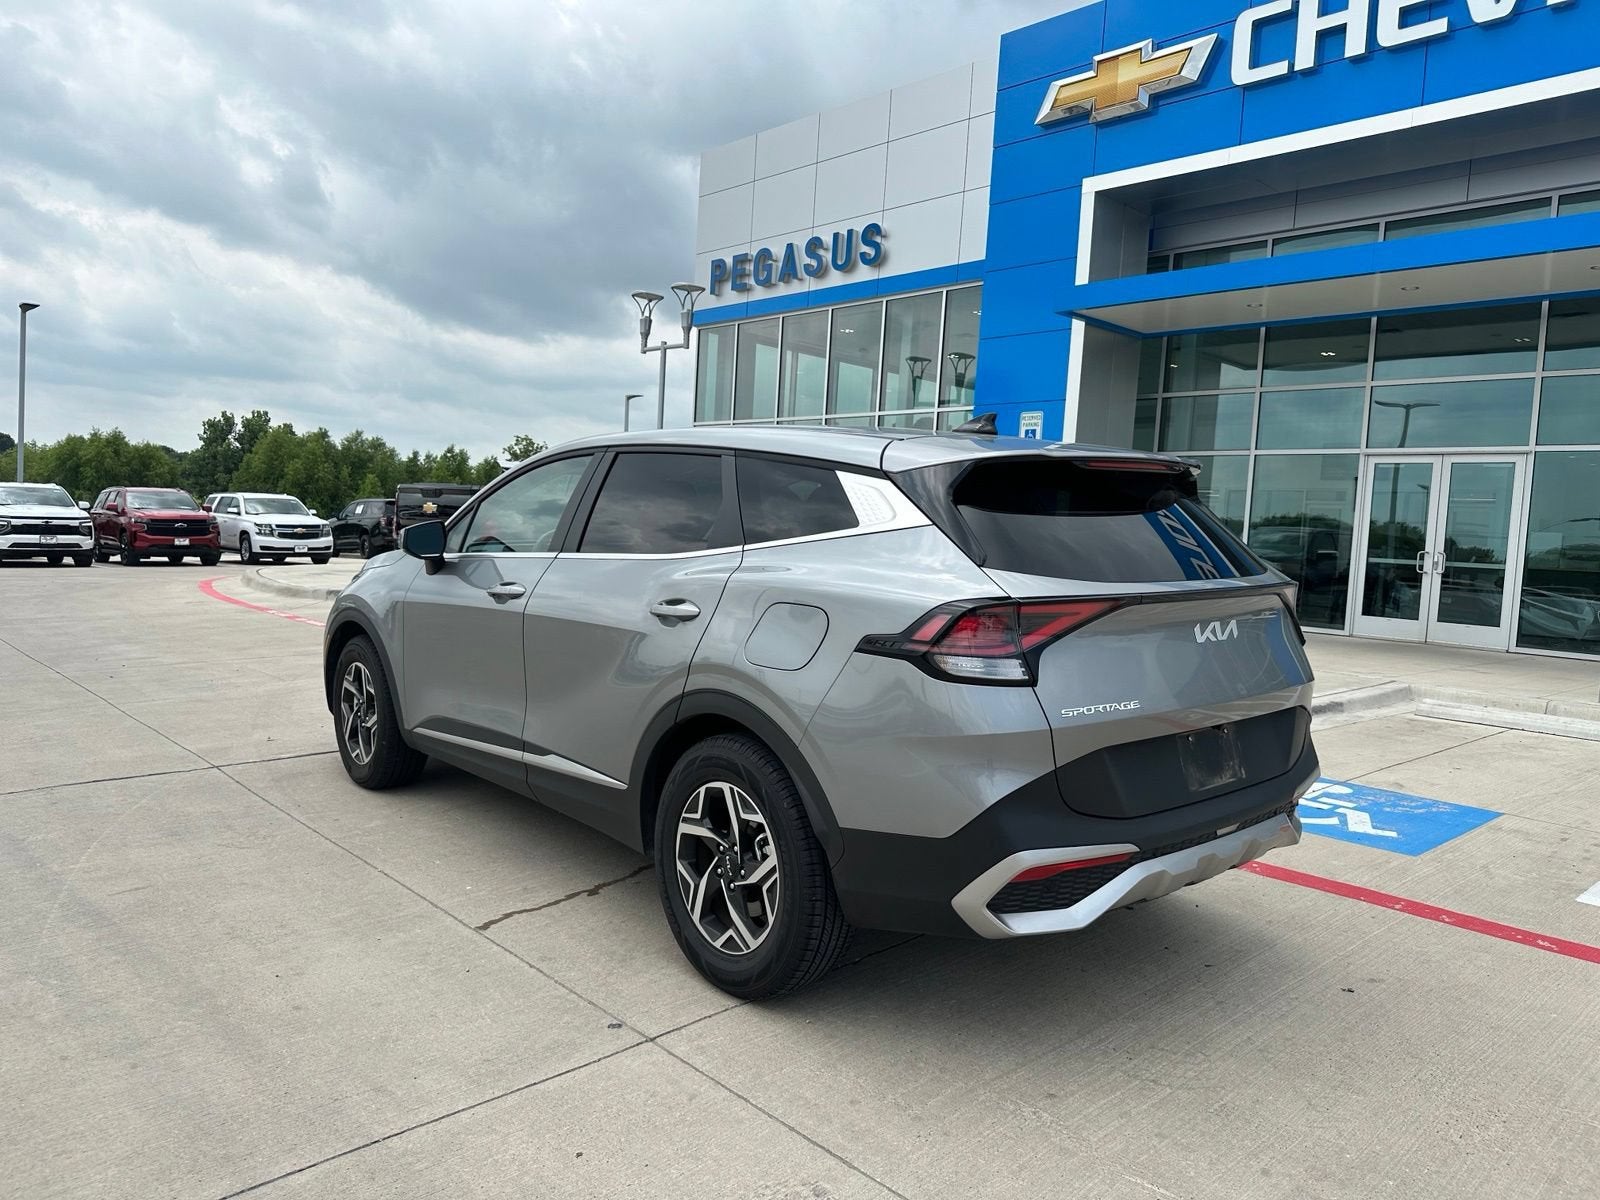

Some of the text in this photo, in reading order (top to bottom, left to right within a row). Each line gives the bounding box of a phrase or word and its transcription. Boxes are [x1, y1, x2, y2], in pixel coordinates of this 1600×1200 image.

[1231, 0, 1576, 86] CHE
[710, 222, 886, 296] PEGASUS
[1061, 700, 1141, 718] SPORTAGE
